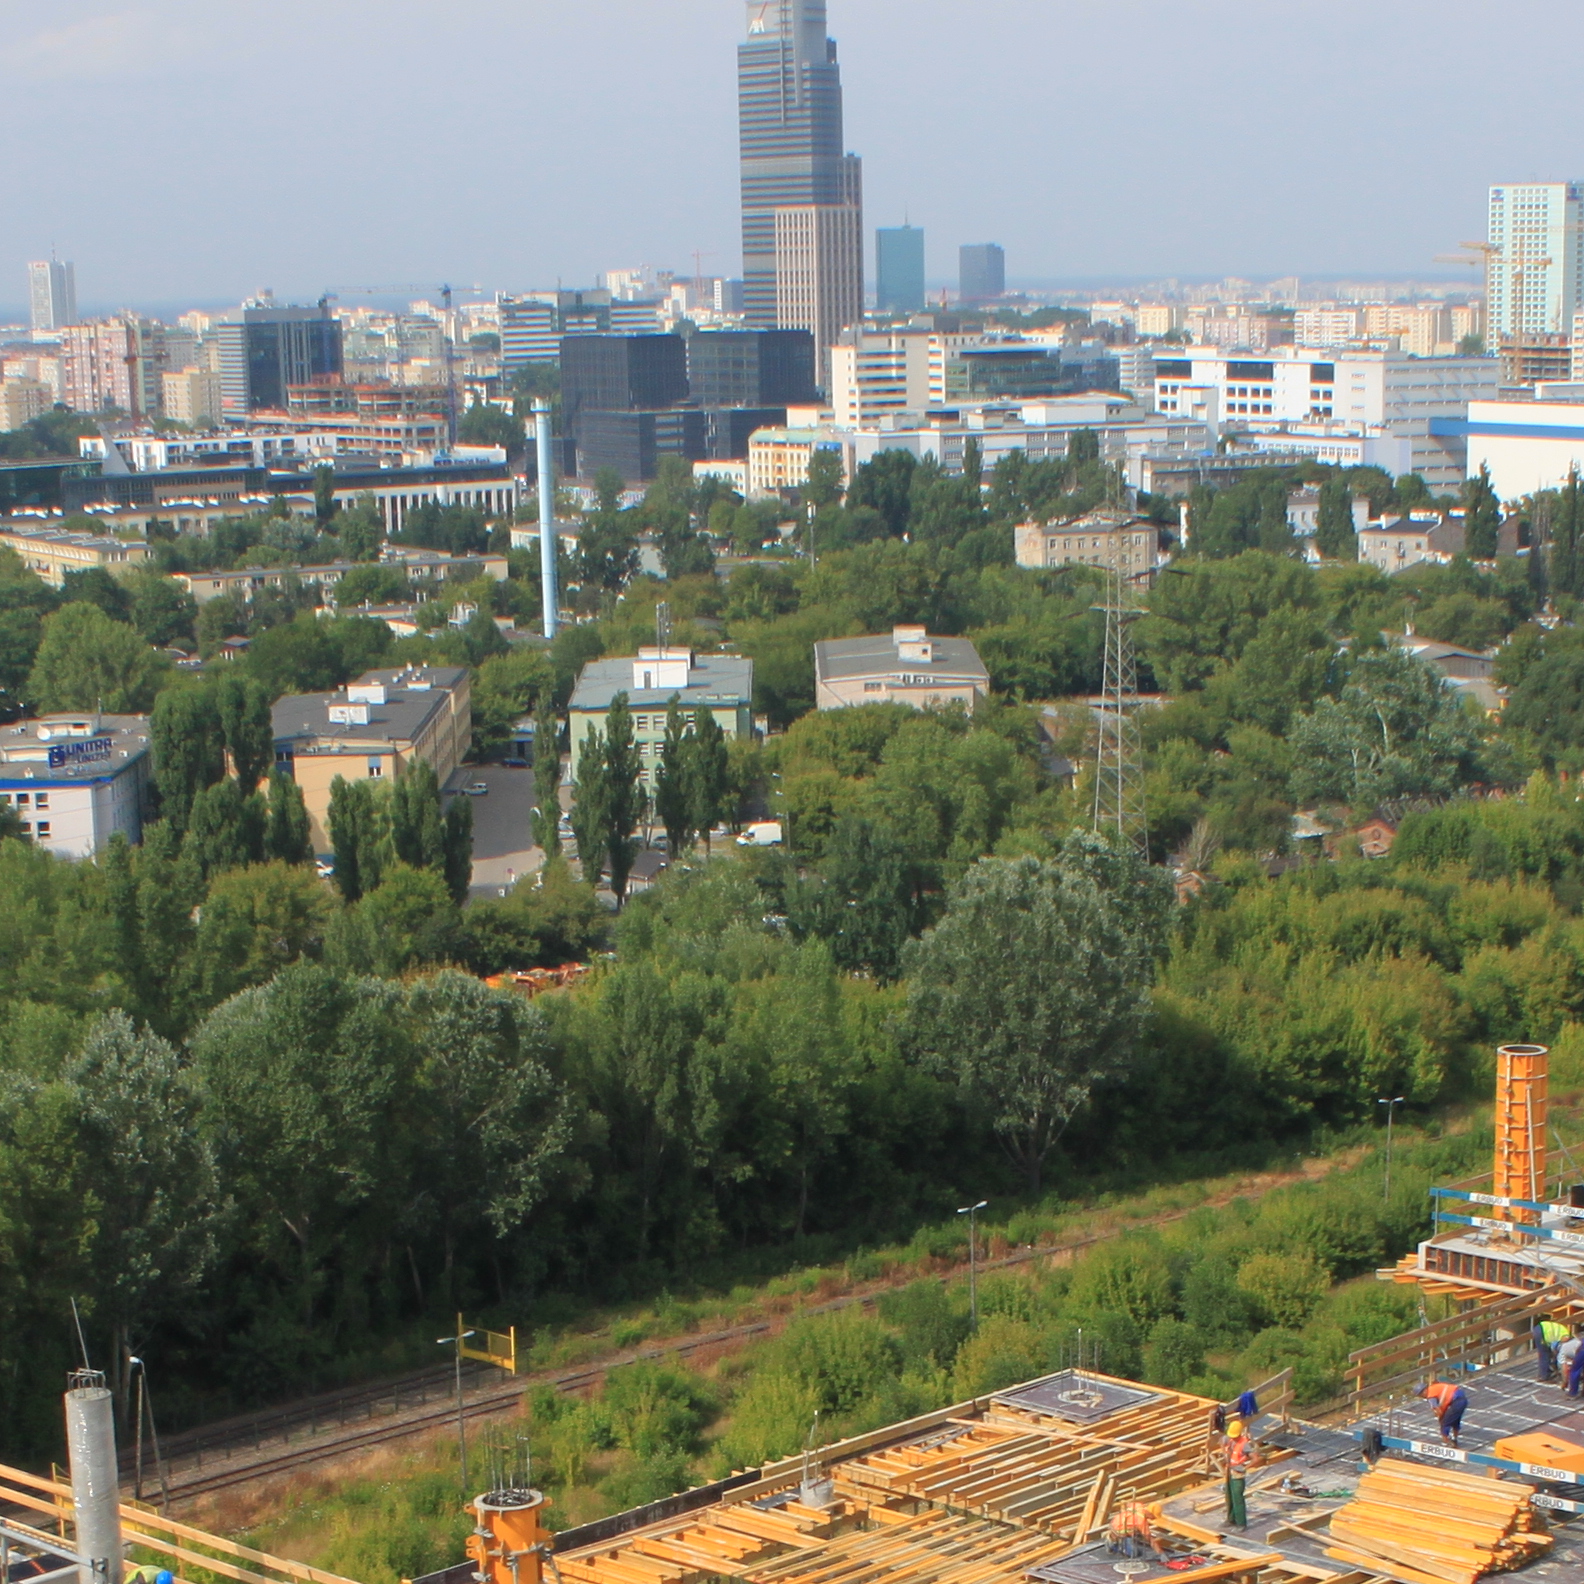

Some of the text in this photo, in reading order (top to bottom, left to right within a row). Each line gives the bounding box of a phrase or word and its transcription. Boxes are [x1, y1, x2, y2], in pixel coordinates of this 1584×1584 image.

[67, 738, 112, 755] UNITRA
[1421, 1443, 1456, 1458] ERBUD
[1530, 1465, 1566, 1479] ERBUD
